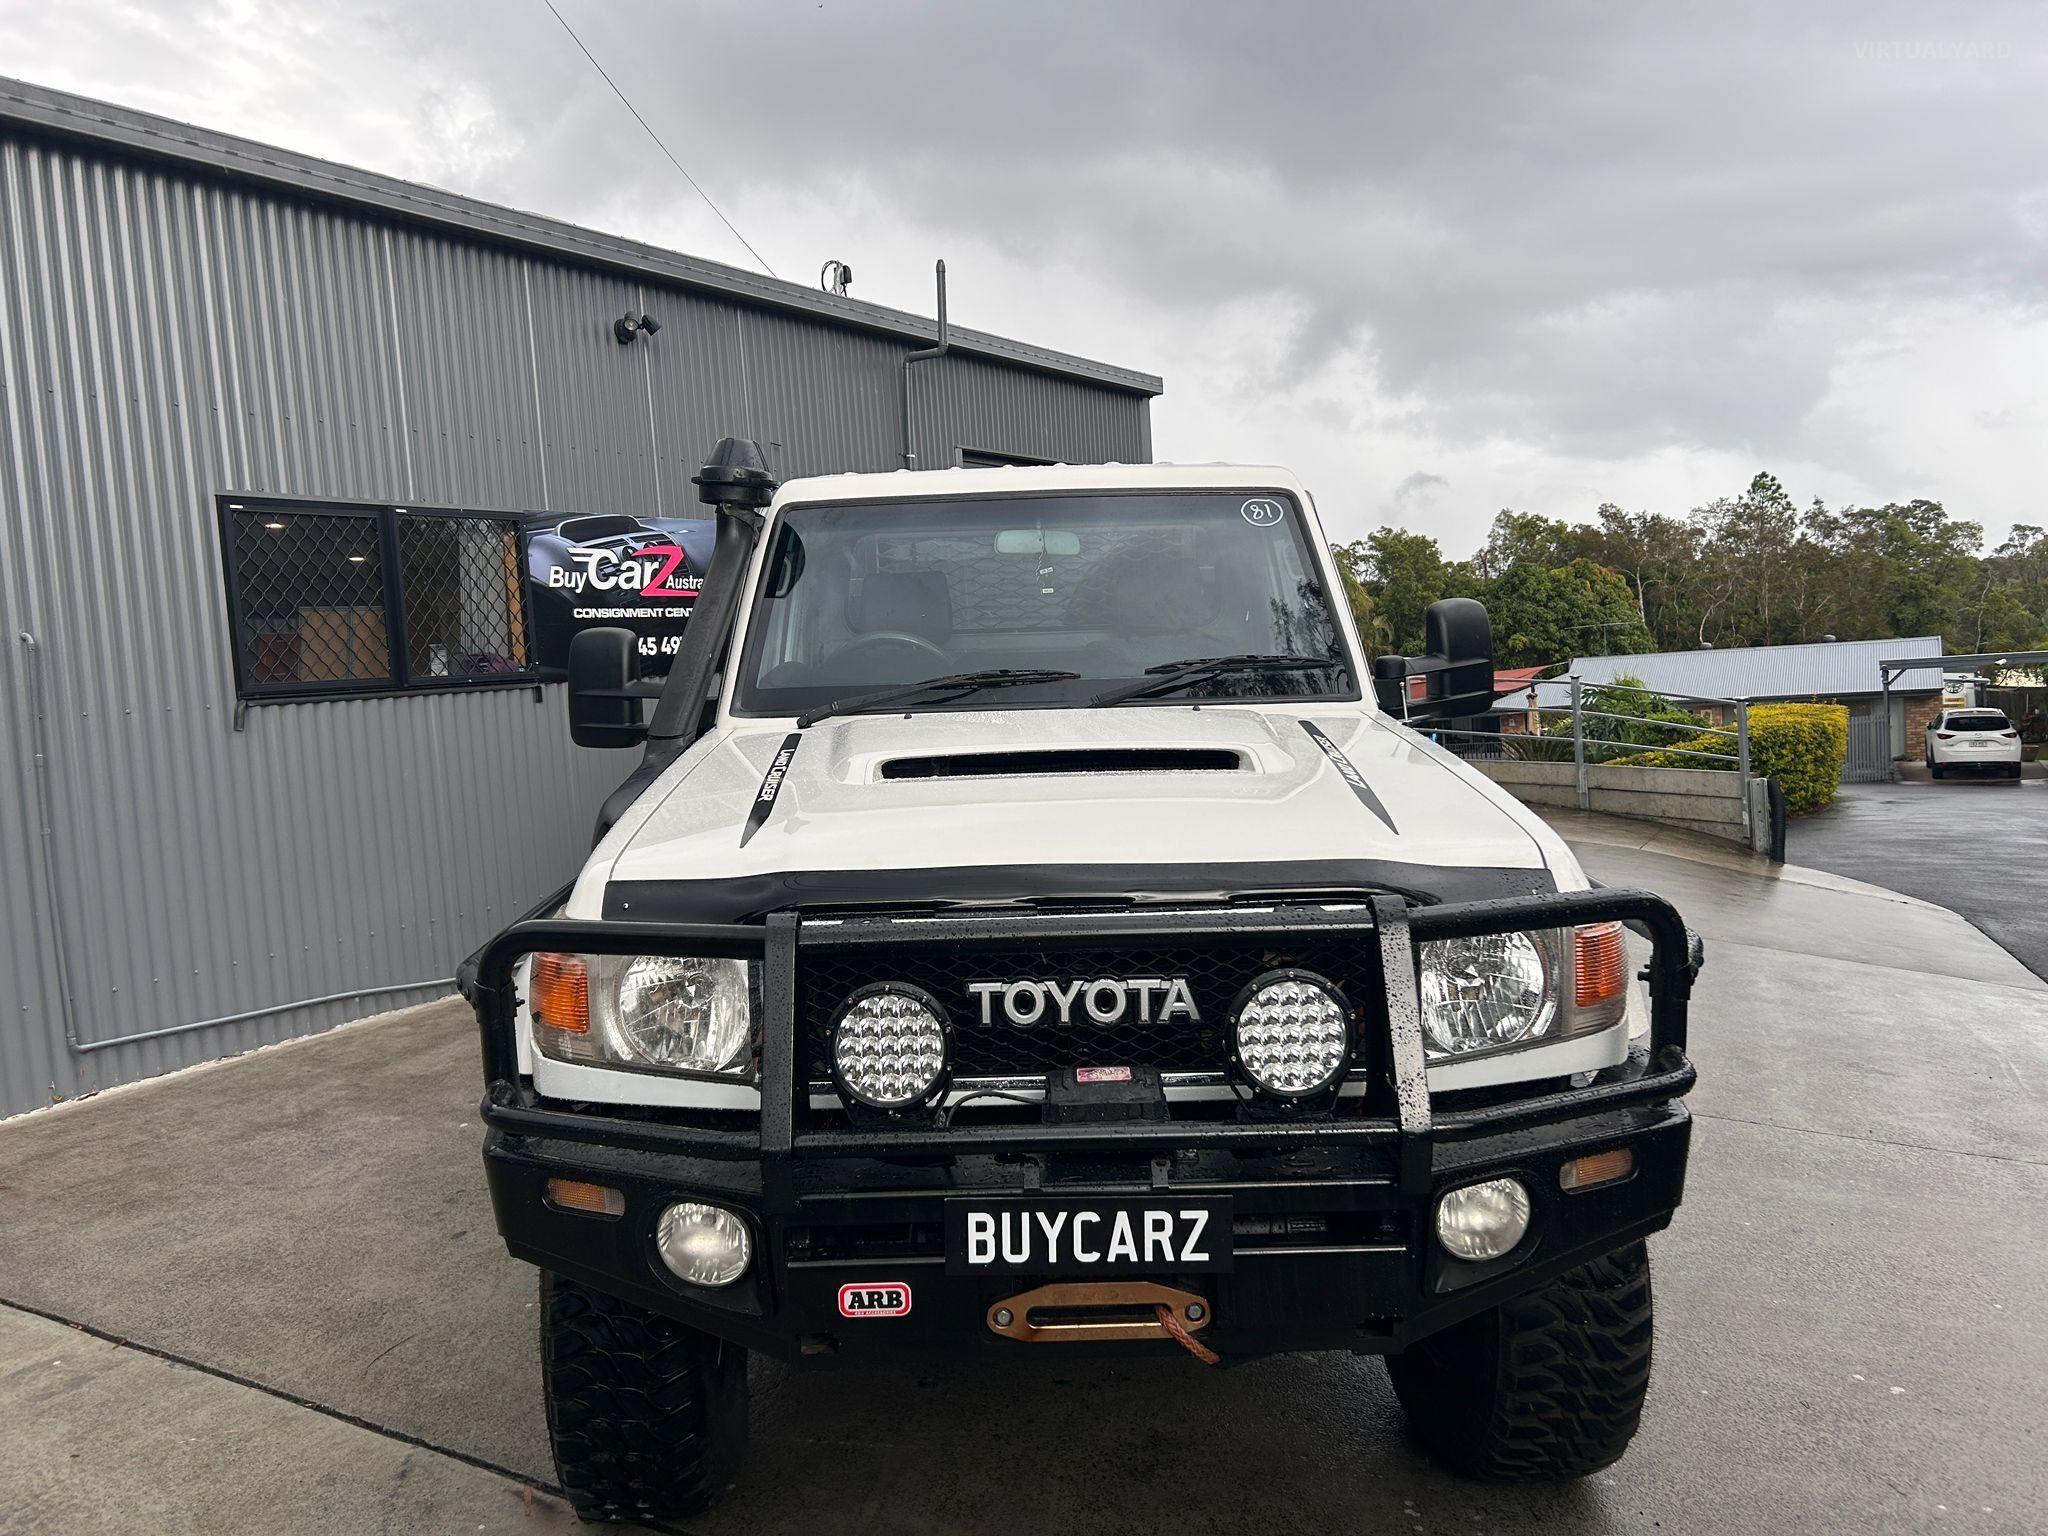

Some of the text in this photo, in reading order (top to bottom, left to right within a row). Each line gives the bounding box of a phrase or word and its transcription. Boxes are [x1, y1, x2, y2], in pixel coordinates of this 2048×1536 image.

[1250, 504, 1272, 519] 81
[573, 607, 664, 619] CONSIGNMENT
[638, 636, 683, 656] 45 49
[968, 979, 1200, 1024] TOYOTA
[967, 1210, 1210, 1264] BUYCARZ
[848, 1290, 903, 1309] ARB
